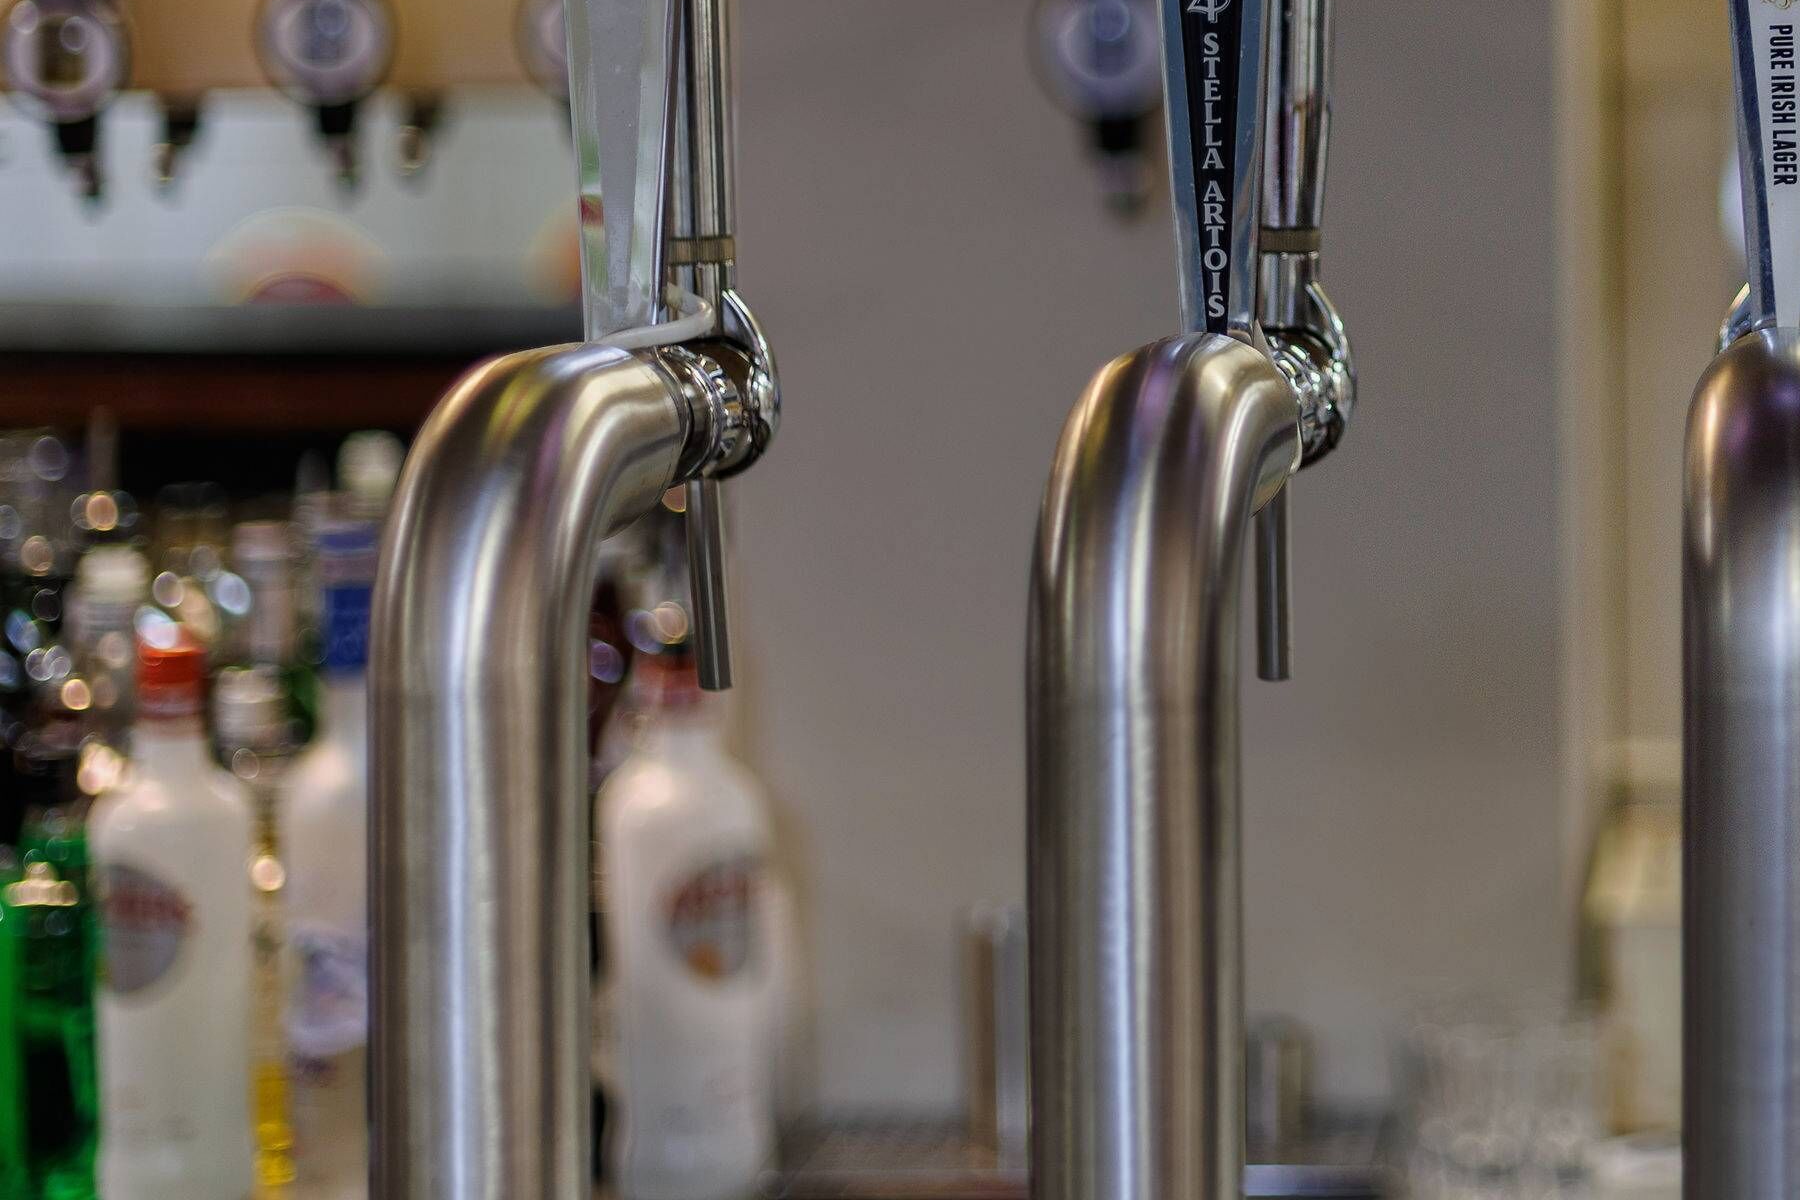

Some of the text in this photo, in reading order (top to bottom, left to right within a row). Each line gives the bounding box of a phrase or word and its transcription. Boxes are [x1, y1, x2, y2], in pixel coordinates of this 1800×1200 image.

[1202, 32, 1227, 318] STELLA ARTOIS
[1769, 24, 1797, 186] PURE IRISH LAGER
